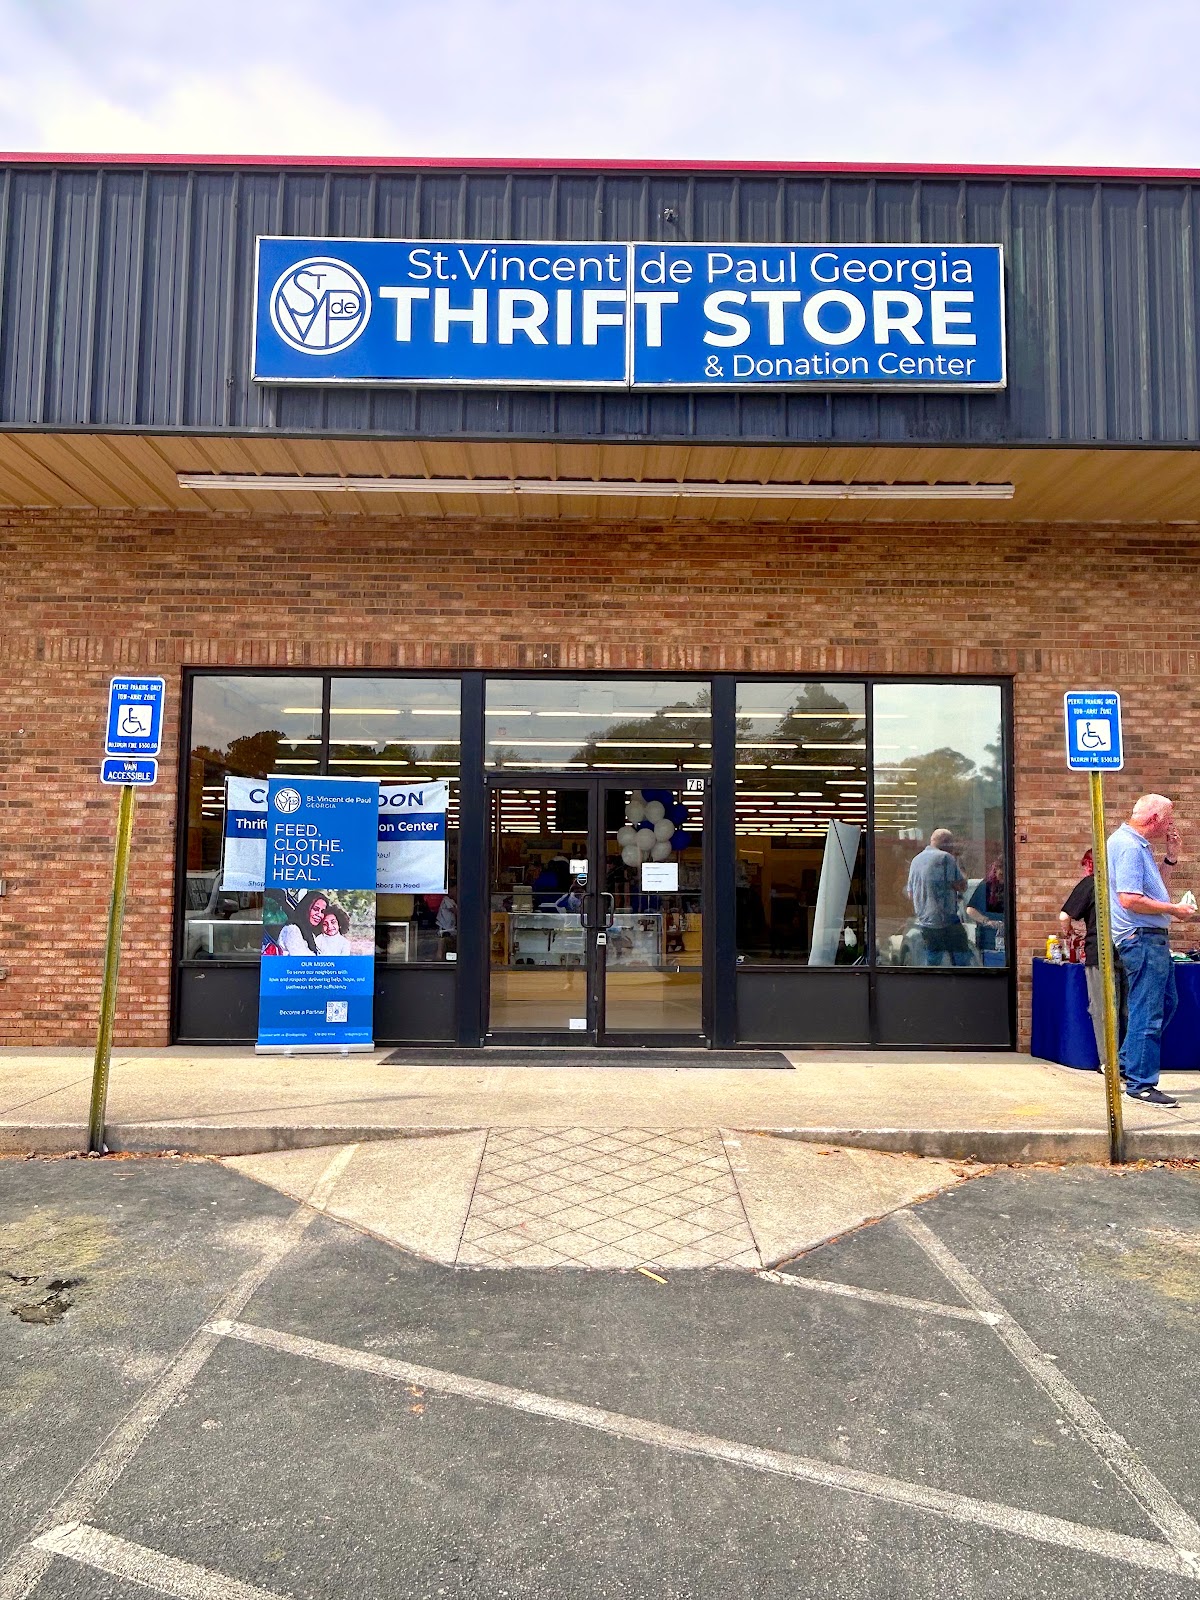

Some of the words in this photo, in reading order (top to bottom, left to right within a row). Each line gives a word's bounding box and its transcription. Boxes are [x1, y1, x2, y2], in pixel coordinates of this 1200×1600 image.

[640, 252, 694, 284] de
[708, 251, 797, 283] Paul
[810, 251, 973, 290] Georgia
[379, 286, 679, 347] THRIFT
[702, 289, 977, 347] STORE
[704, 354, 725, 378] &
[733, 352, 869, 377] Donation
[878, 351, 977, 375] Center
[123, 762, 138, 771] VAN
[107, 771, 152, 781] ACCESSIBLE
[274, 824, 322, 837] FEED.
[397, 821, 439, 832] Center
[274, 839, 344, 852] CLOTHE.
[273, 854, 335, 867] HOUSE.
[273, 868, 321, 881] HEAL.
